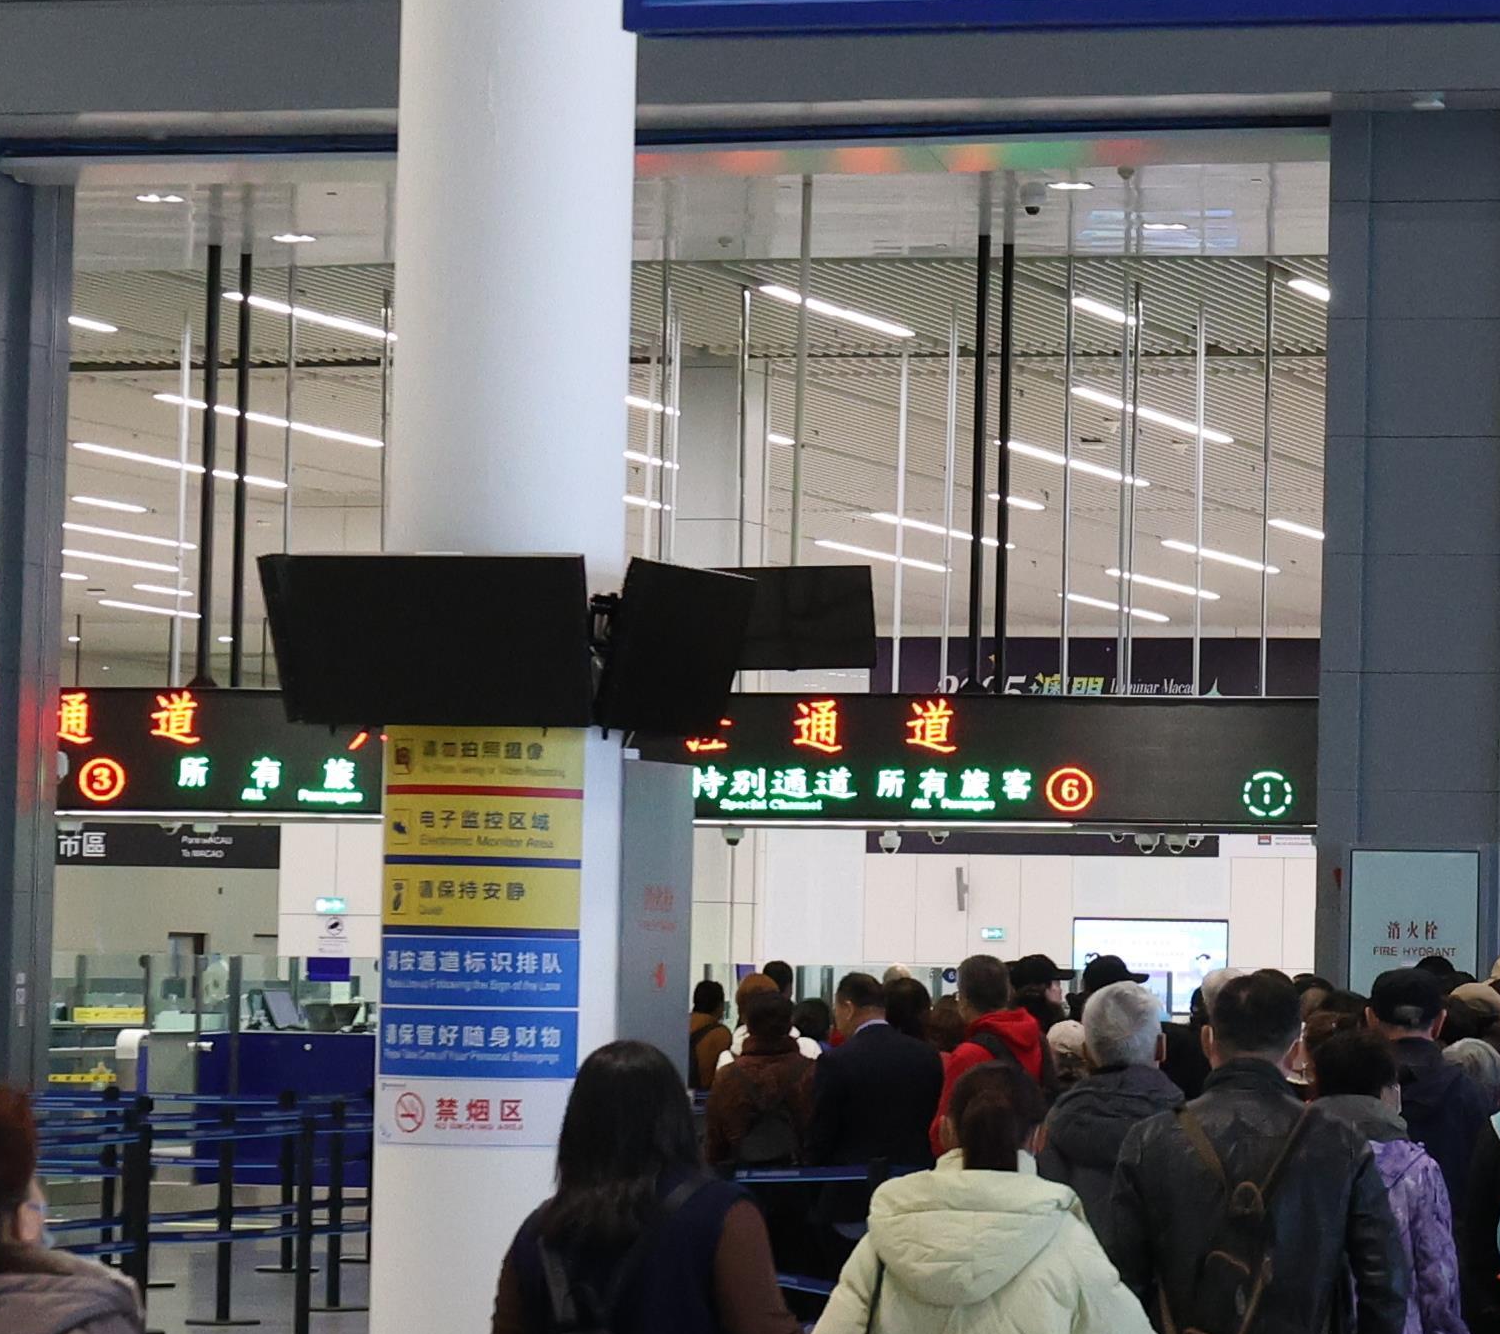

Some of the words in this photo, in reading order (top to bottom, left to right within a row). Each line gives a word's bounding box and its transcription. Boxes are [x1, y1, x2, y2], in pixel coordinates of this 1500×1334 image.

[420, 810, 550, 831] 电子监控区域
[1373, 947, 1398, 957] FIRE
[436, 1098, 523, 1122] 禁烟区
